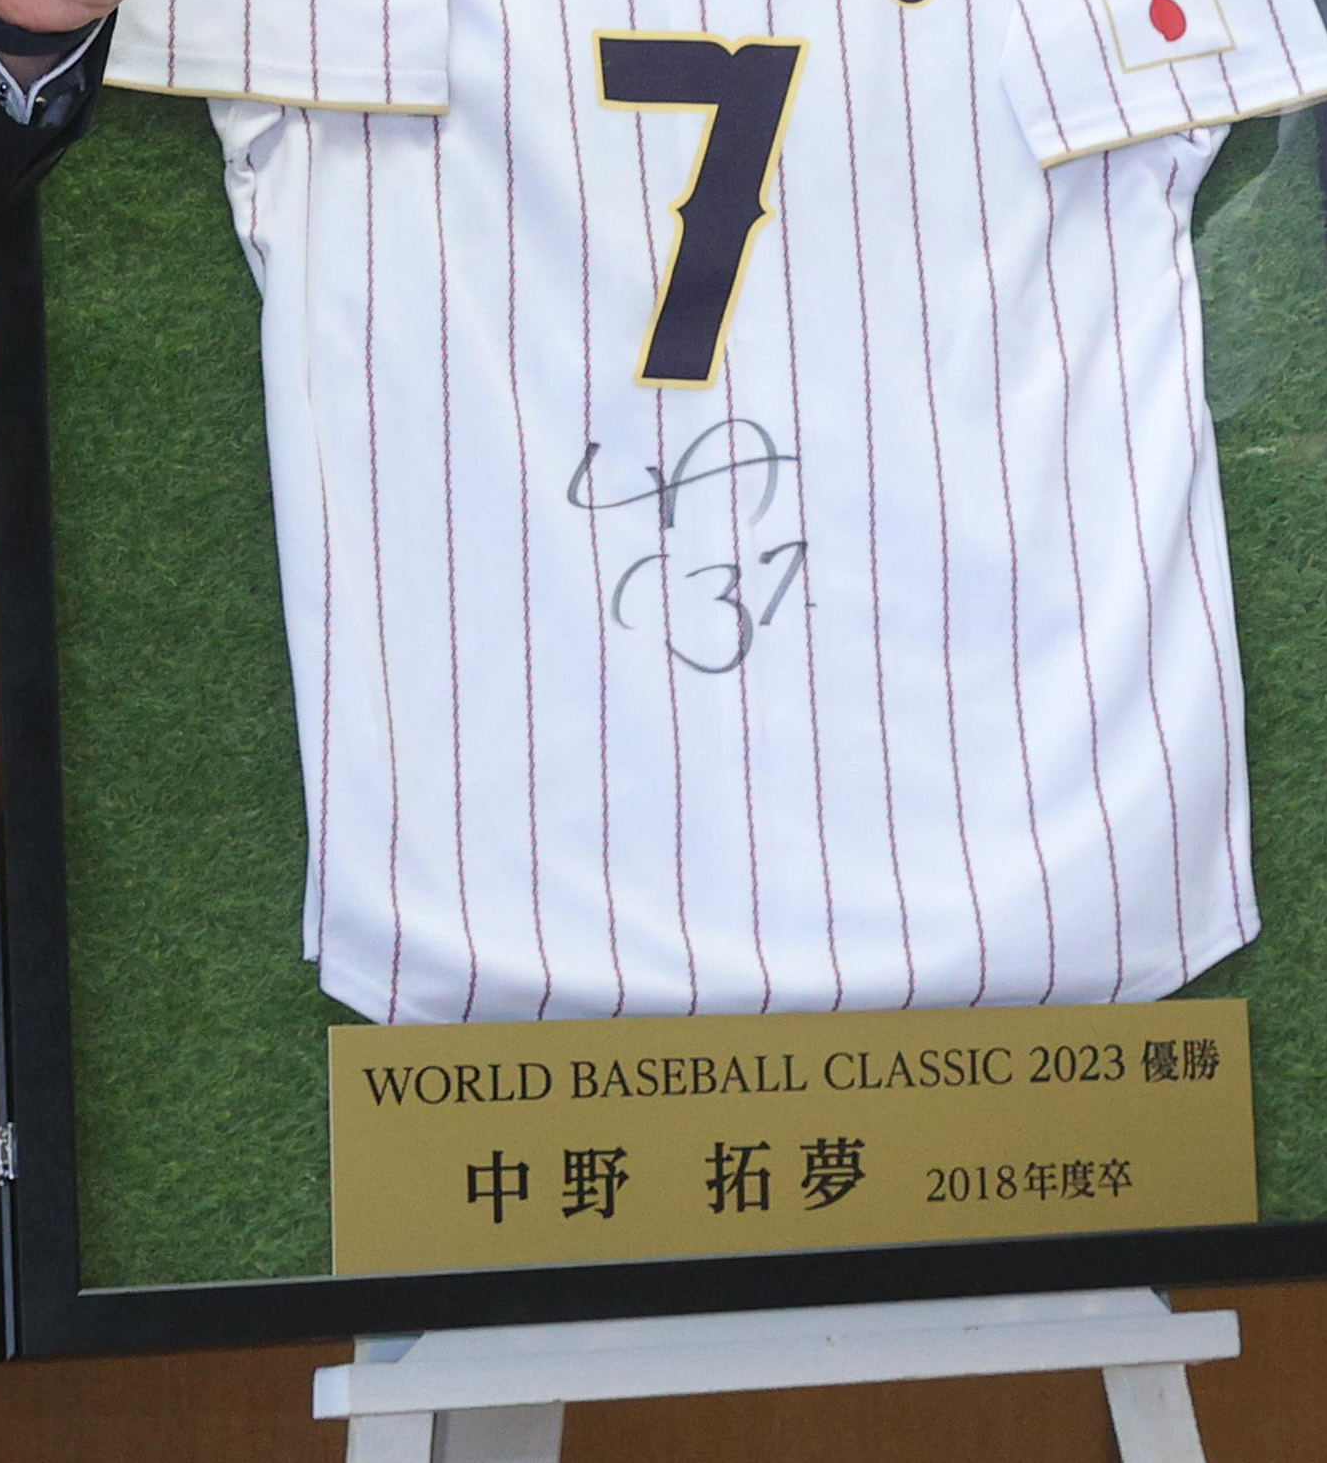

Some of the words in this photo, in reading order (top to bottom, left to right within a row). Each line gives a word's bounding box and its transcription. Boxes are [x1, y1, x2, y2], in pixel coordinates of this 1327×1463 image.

[592, 29, 809, 390] 7
[363, 1062, 552, 1106] WORLD
[569, 1054, 808, 1100] BASEBALL
[824, 1047, 1013, 1090] CLASSIC
[1029, 1044, 1126, 1083] 2023
[1140, 1038, 1220, 1084] 優勝
[466, 1146, 629, 1225] 中野
[704, 1136, 866, 1215] 拓夢
[926, 1158, 1133, 1203] 2018年度卒
